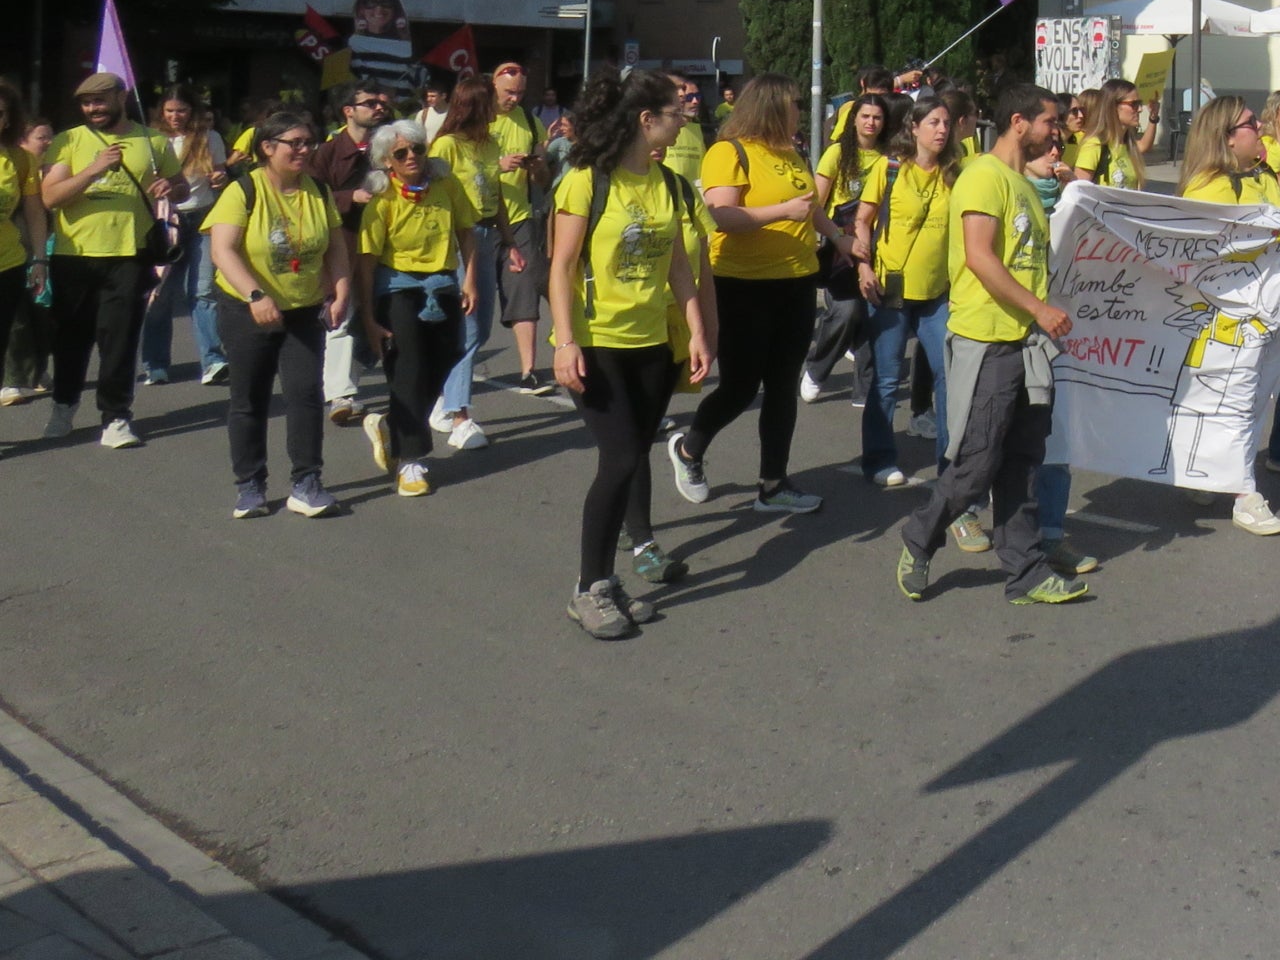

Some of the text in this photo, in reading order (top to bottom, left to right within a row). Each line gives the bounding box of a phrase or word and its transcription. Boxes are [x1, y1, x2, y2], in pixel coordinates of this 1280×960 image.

[1053, 19, 1081, 46] ENS
[1136, 229, 1220, 262] MESTRES
[1071, 268, 1142, 298] també
[1077, 296, 1148, 322] estem
